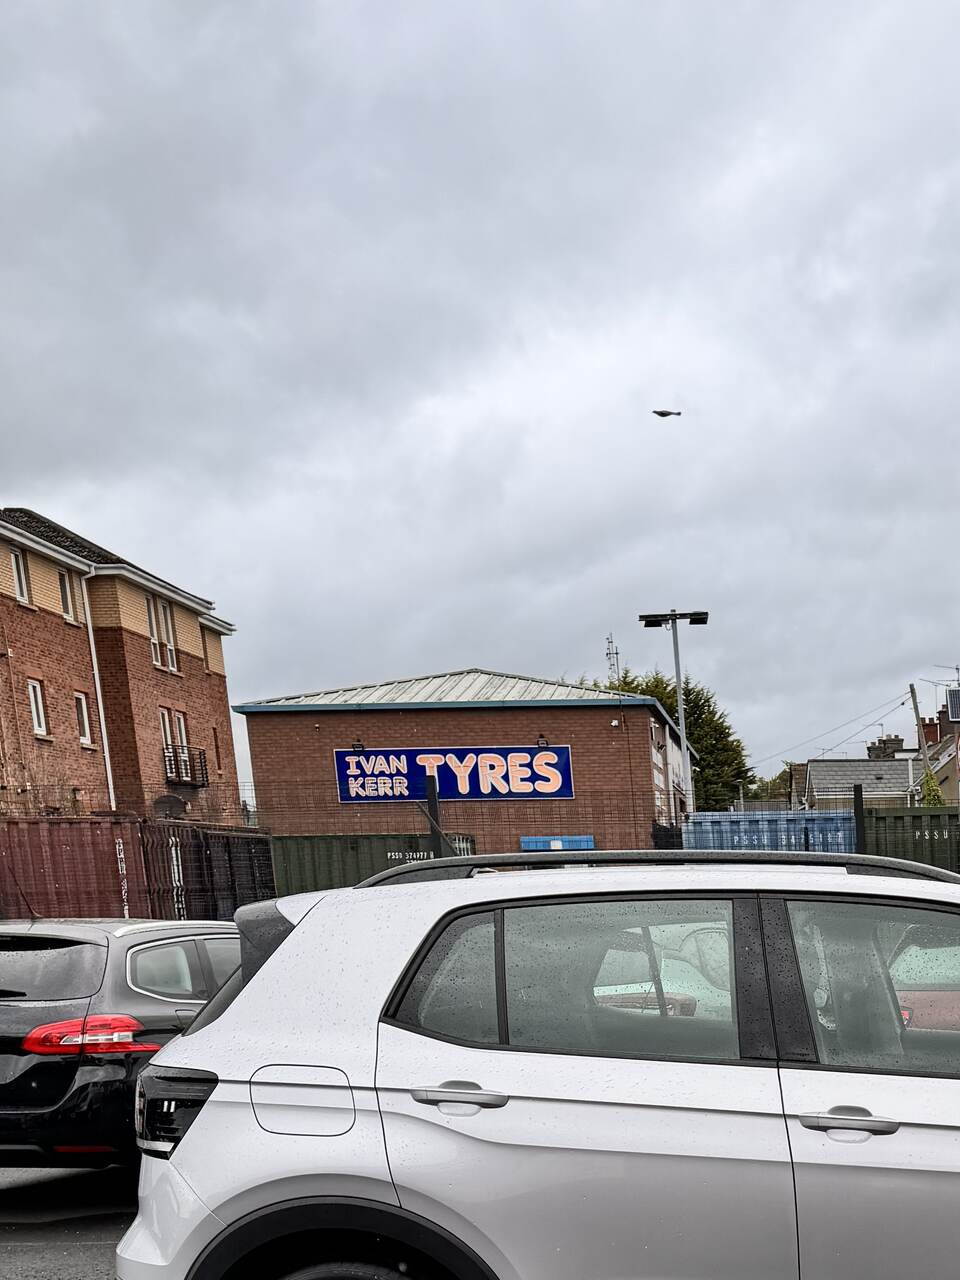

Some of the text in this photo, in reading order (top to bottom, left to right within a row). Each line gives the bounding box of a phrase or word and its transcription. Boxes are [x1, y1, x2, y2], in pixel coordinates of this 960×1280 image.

[345, 755, 408, 775] IVAN
[415, 751, 563, 795] TYRES
[349, 777, 409, 798] KERR
